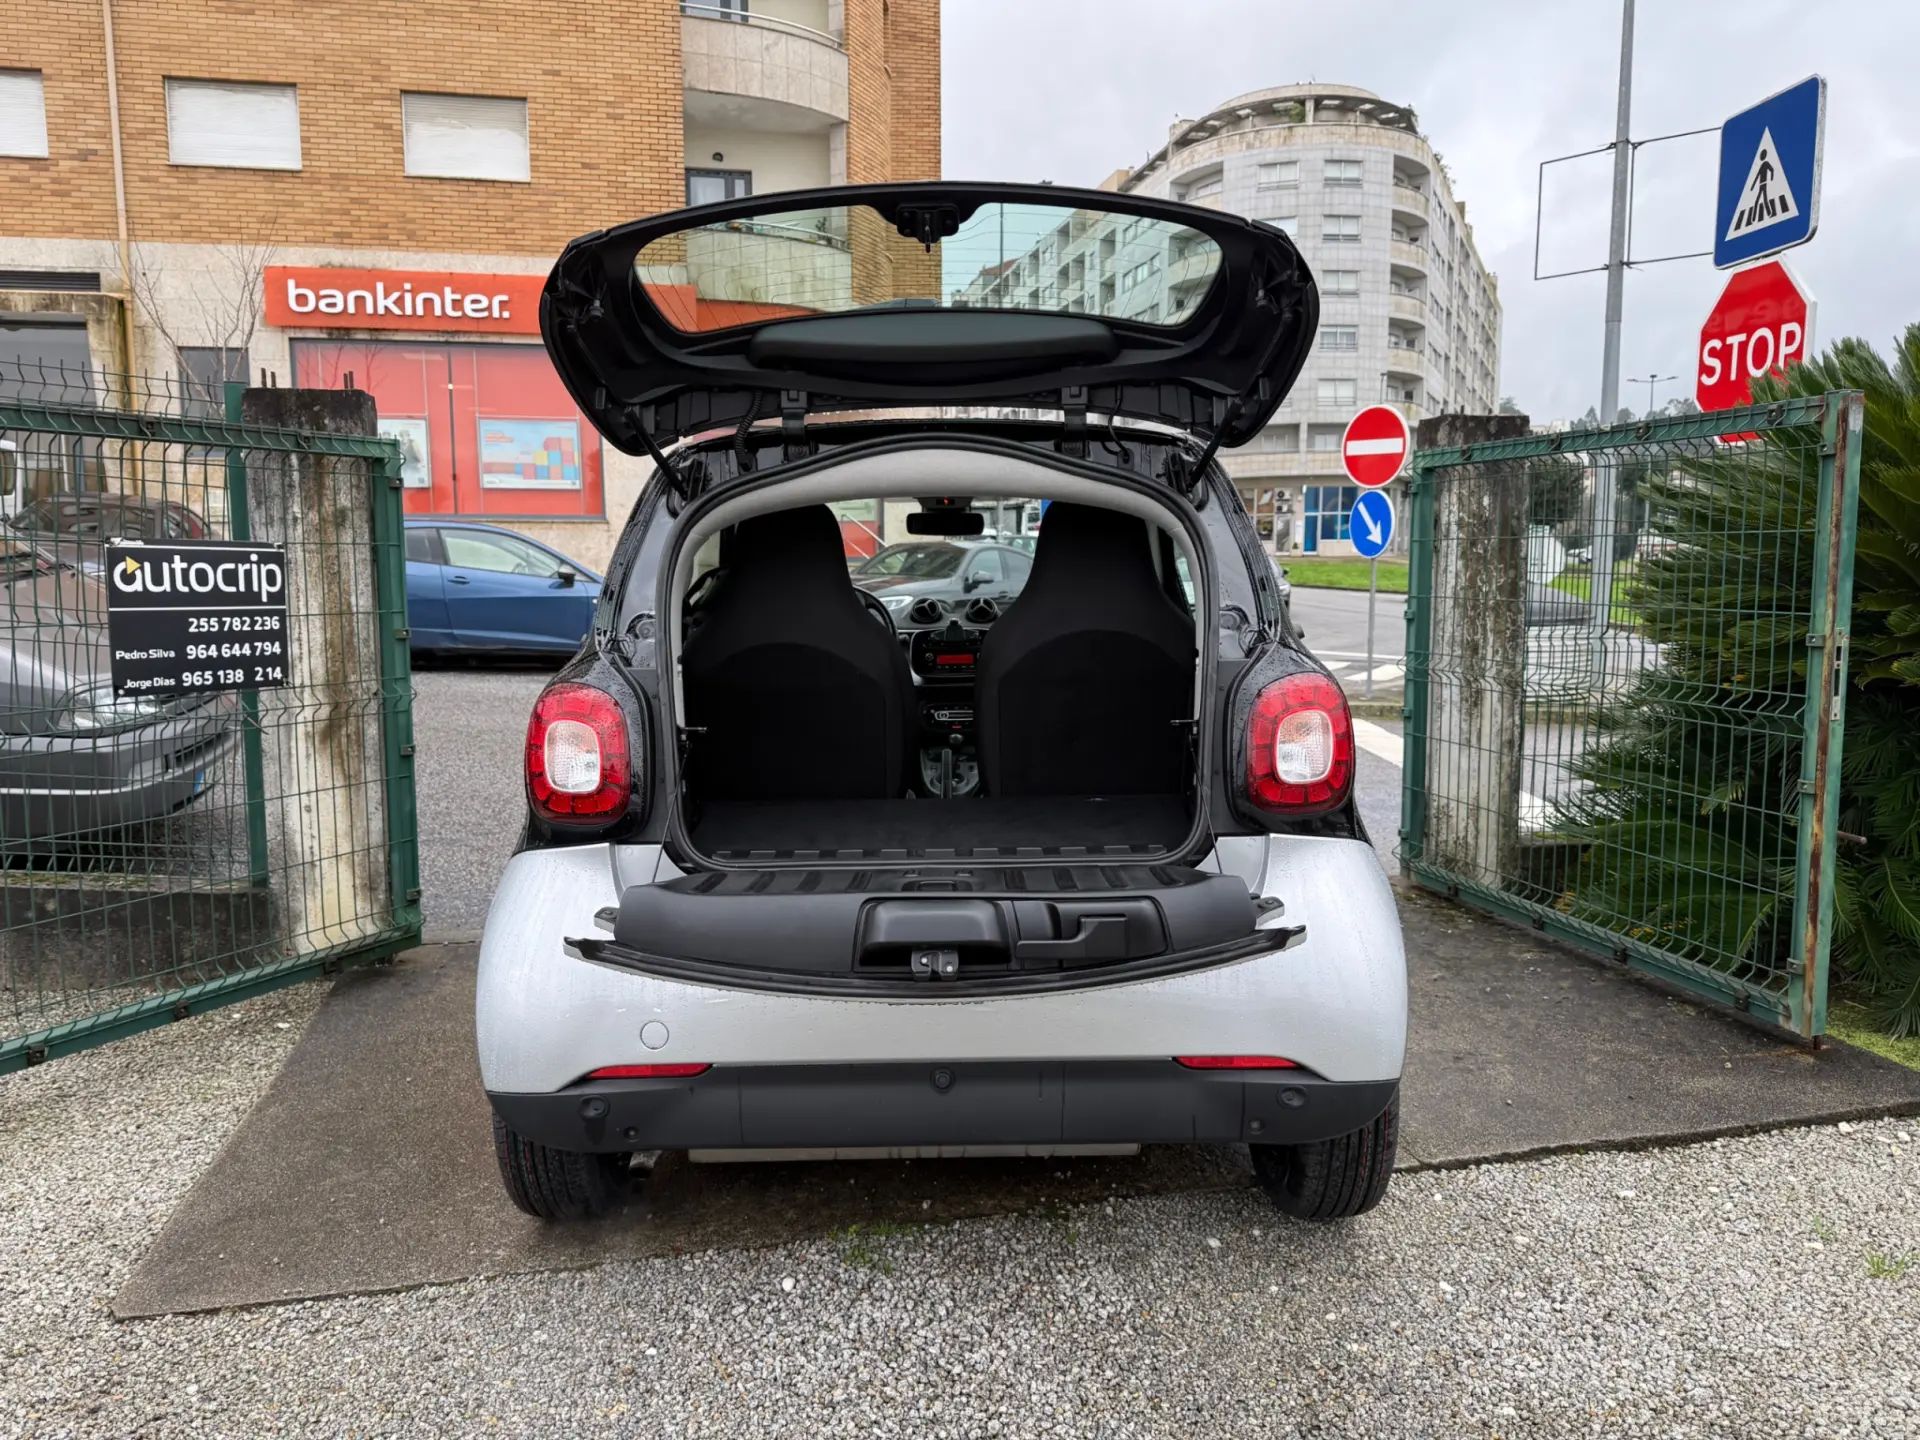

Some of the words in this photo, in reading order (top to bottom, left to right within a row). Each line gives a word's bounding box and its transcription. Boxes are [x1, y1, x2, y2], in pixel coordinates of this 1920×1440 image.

[287, 278, 510, 319] bankinter.
[1700, 322, 1802, 386] STOP
[113, 553, 282, 602] autocrip
[188, 617, 219, 632] 255
[222, 616, 252, 631] 782
[253, 616, 280, 630] 236
[115, 649, 148, 660] Pedro
[149, 649, 176, 659] Silva
[186, 644, 218, 659] 964
[221, 643, 252, 657] 644
[253, 641, 282, 655] 794
[124, 678, 152, 689] Jorge
[153, 677, 176, 687] Dias
[182, 671, 213, 686] 965
[217, 669, 244, 684] 138
